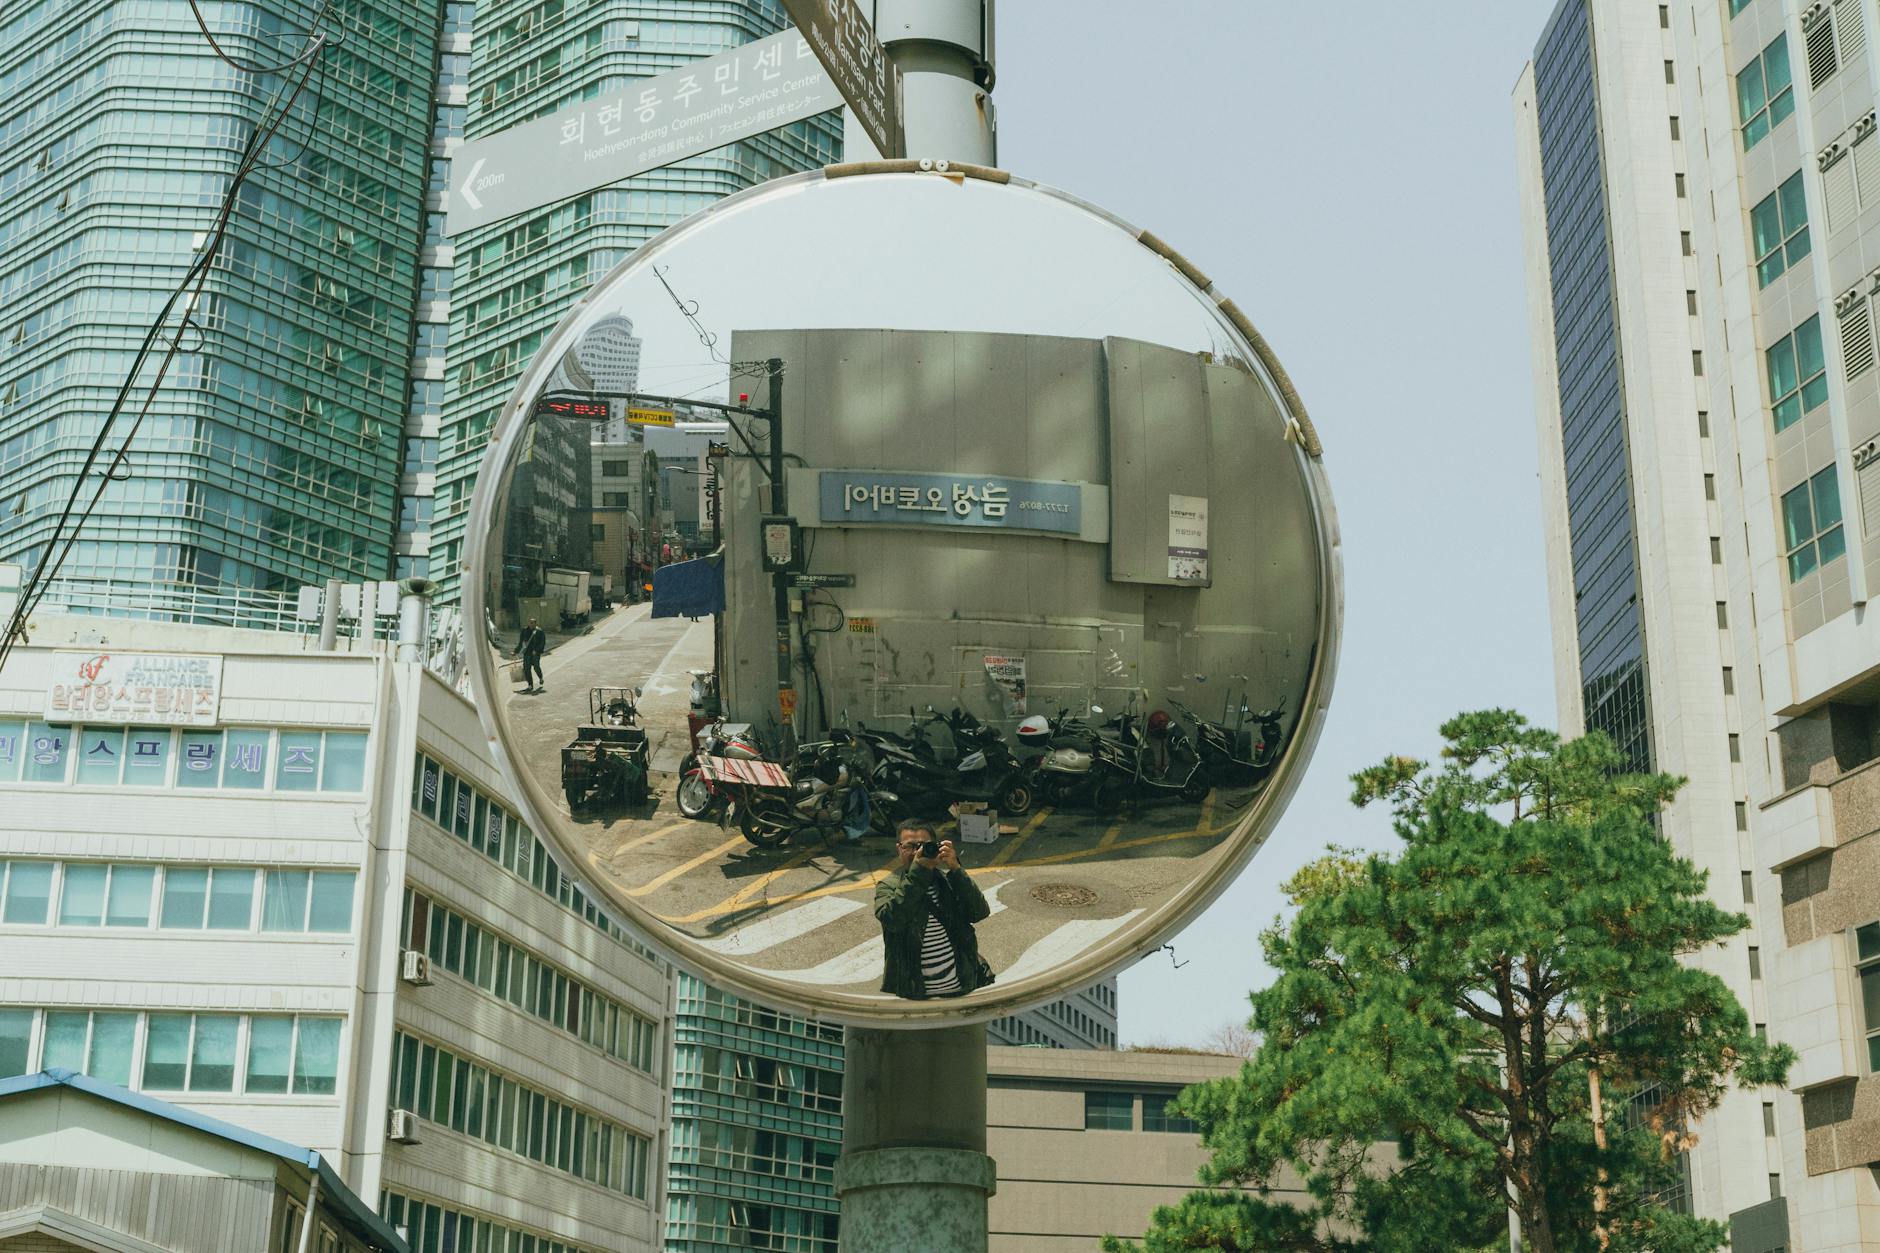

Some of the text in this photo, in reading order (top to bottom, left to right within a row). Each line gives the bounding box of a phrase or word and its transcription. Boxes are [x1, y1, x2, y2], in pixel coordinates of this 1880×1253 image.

[834, 27, 886, 123] Namsan Park
[584, 72, 822, 163] Hoehyeon-dong Community Service Center
[476, 172, 505, 192] 200m
[132, 657, 210, 674] ALLIANCE
